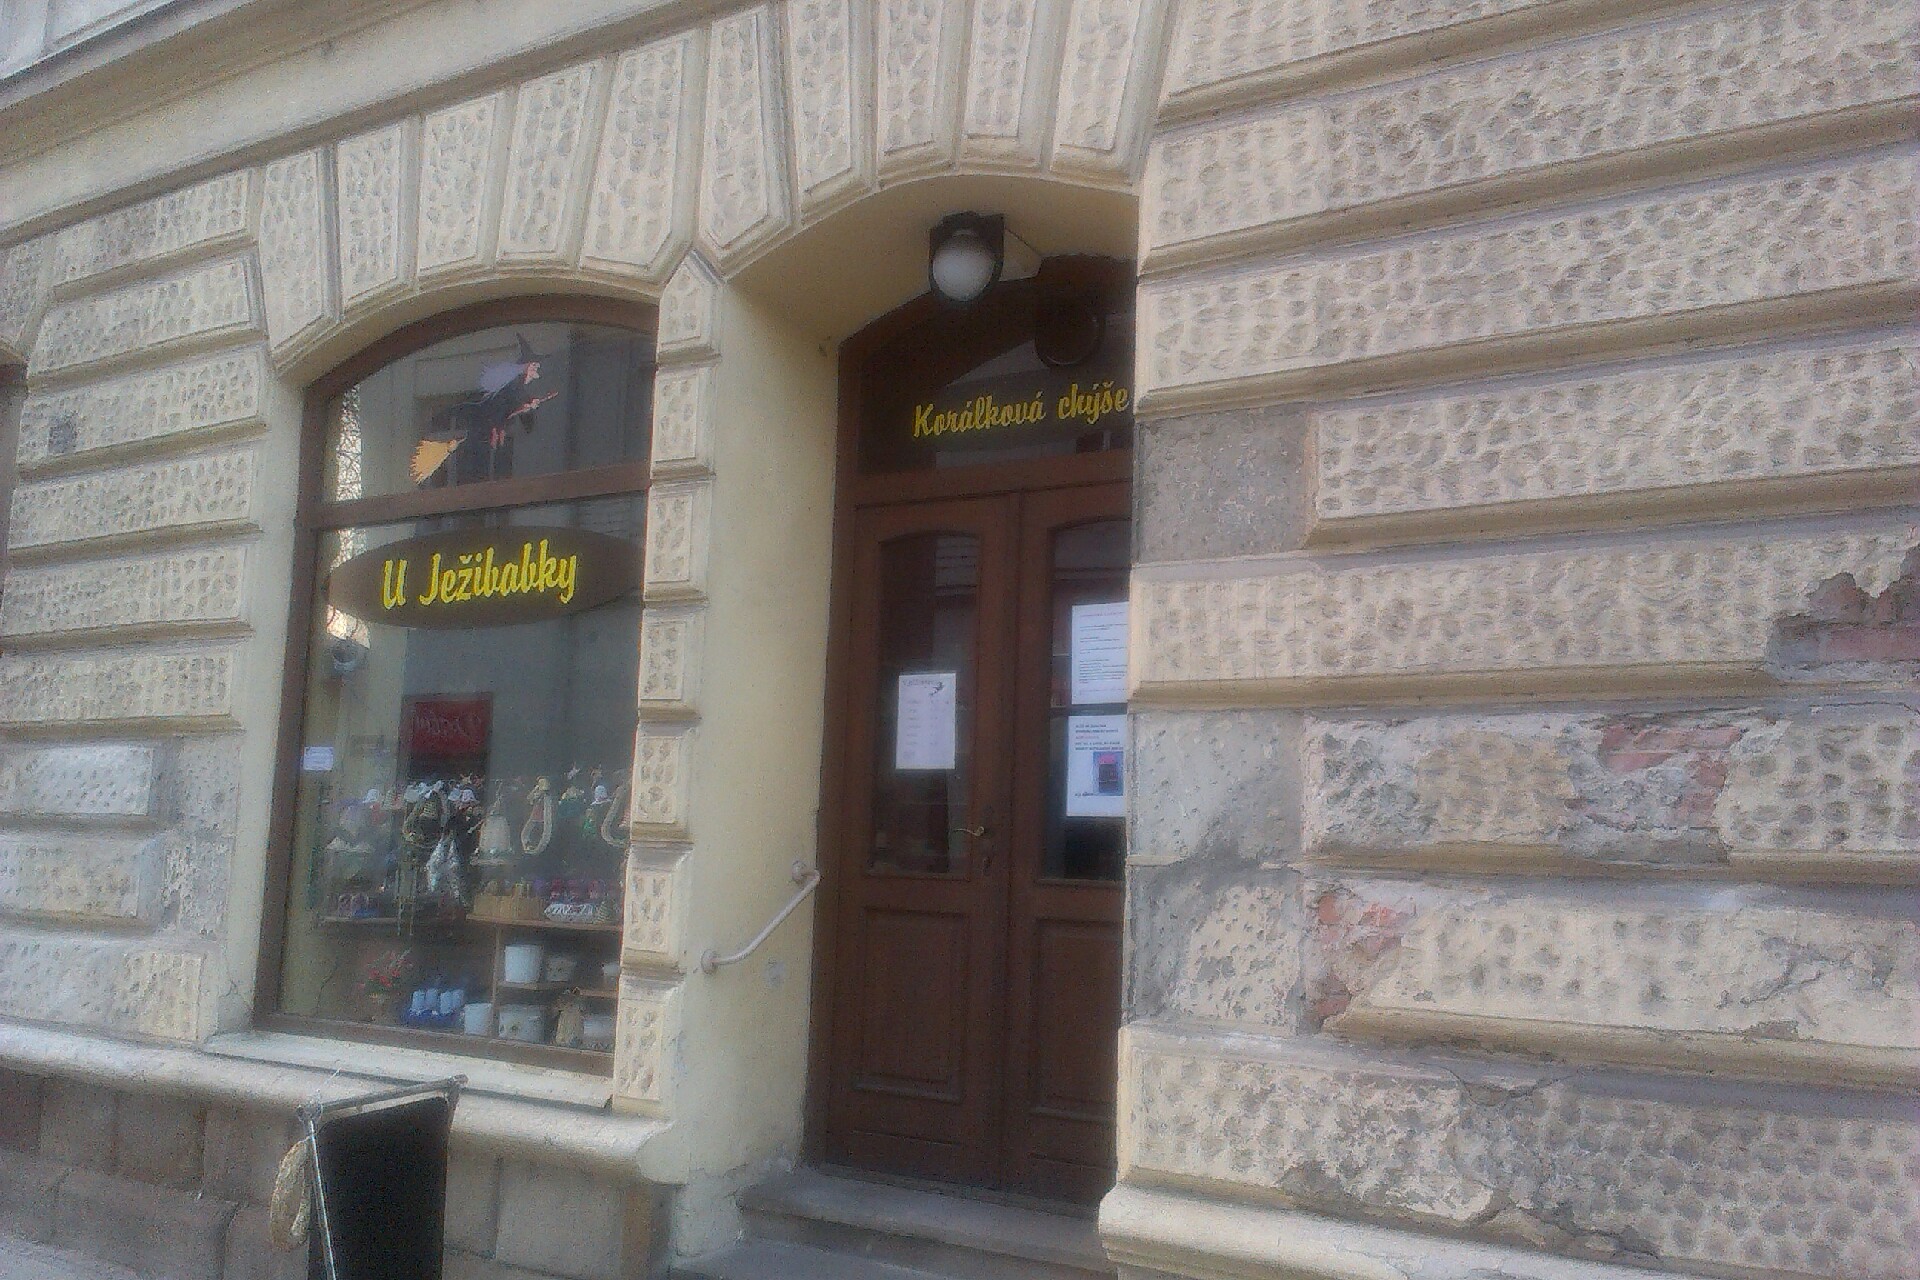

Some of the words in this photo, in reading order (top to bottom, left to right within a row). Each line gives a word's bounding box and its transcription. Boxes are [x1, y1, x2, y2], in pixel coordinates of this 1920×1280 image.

[912, 390, 1047, 438] Korálková
[1056, 380, 1130, 424] chýše
[382, 558, 408, 610] U
[418, 538, 578, 605] Ježibabky
